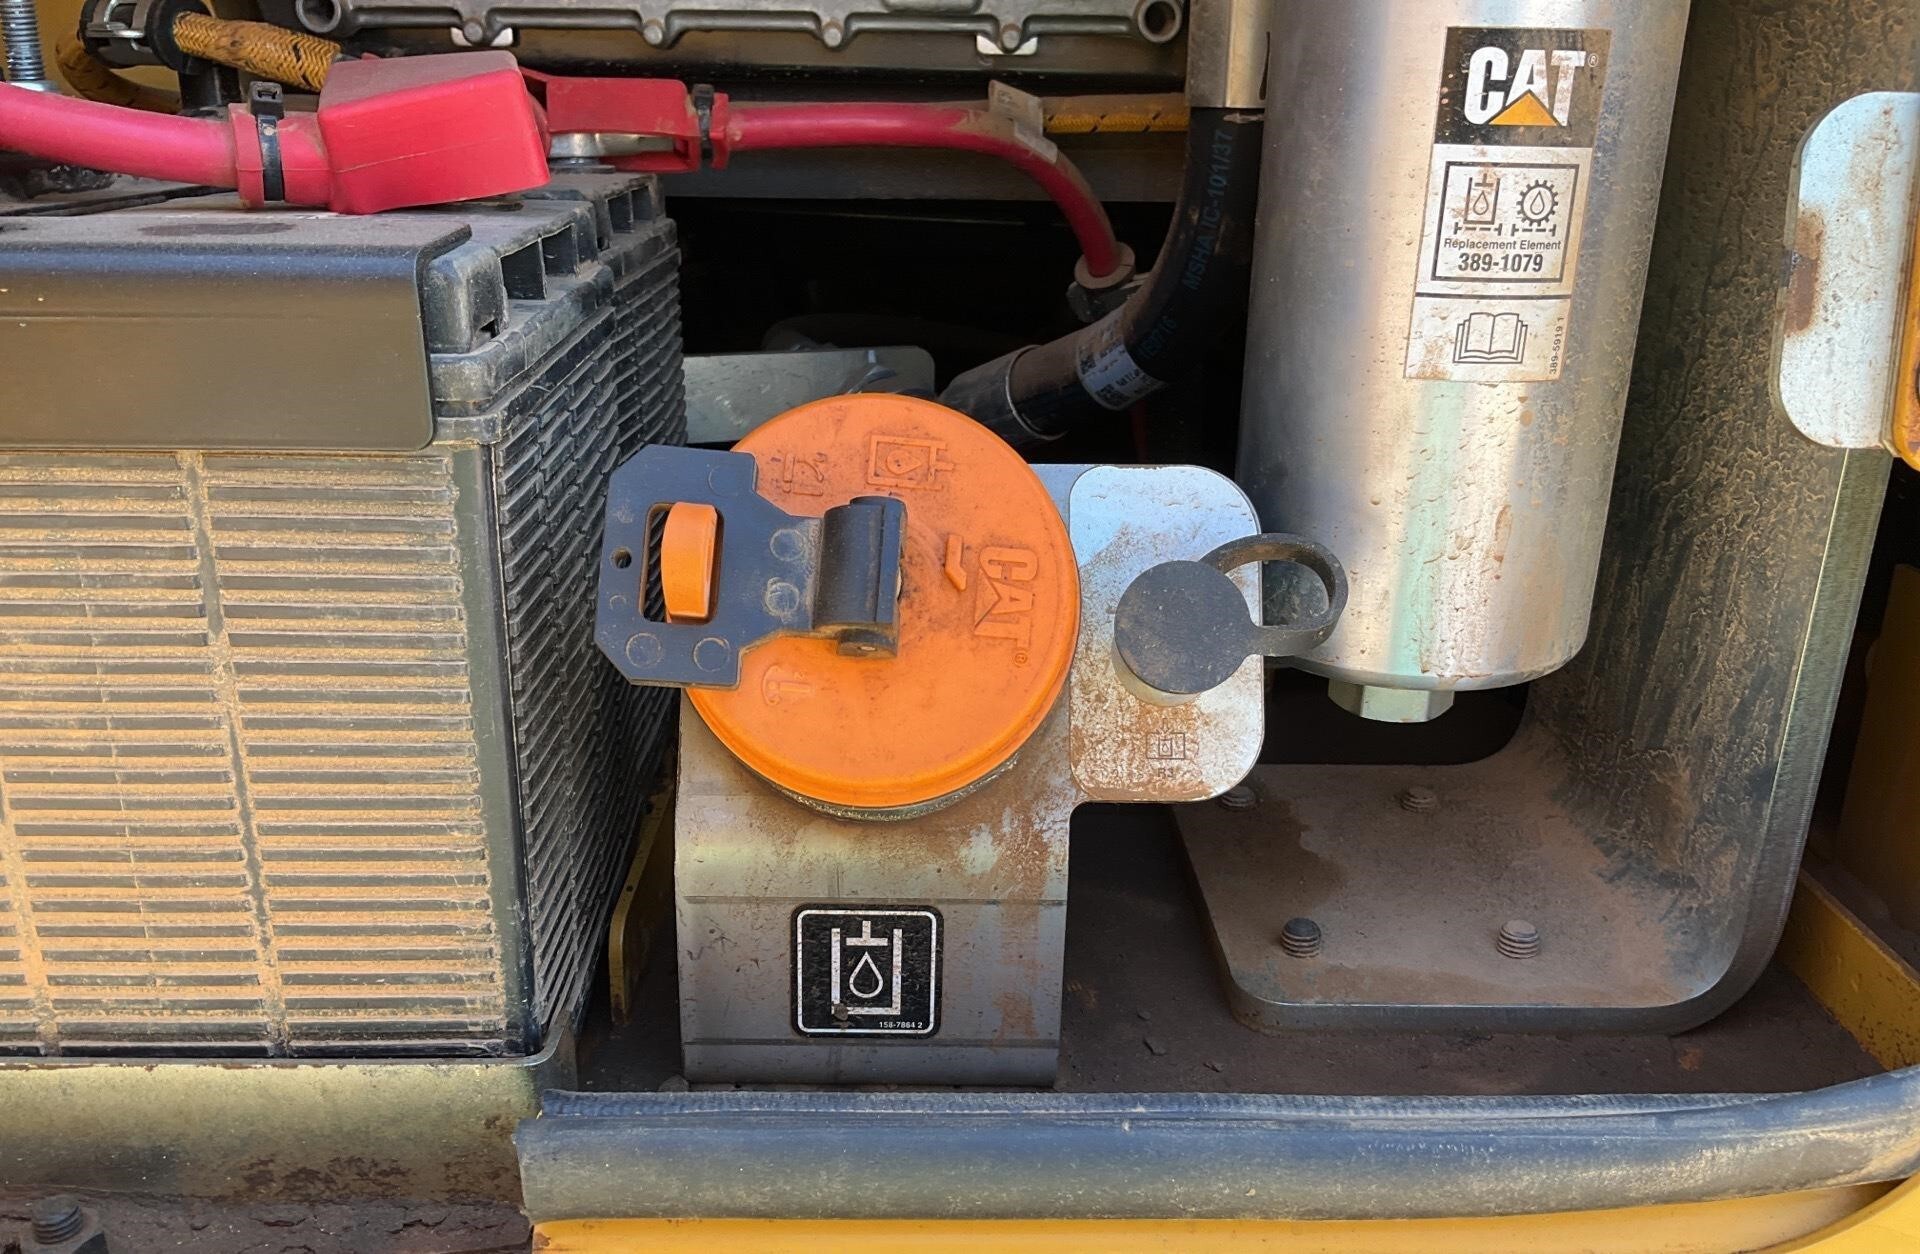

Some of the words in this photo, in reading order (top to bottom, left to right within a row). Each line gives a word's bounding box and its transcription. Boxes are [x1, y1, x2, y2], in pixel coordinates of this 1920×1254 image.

[1444, 238, 1517, 251] Replacement
[1520, 240, 1561, 250] Element
[1183, 234, 1214, 290] MSHA
[1458, 252, 1544, 272] 389-1079
[1549, 325, 1562, 374] 389-5919
[879, 1021, 916, 1030] 158-7864
[917, 1022, 923, 1030] 2
